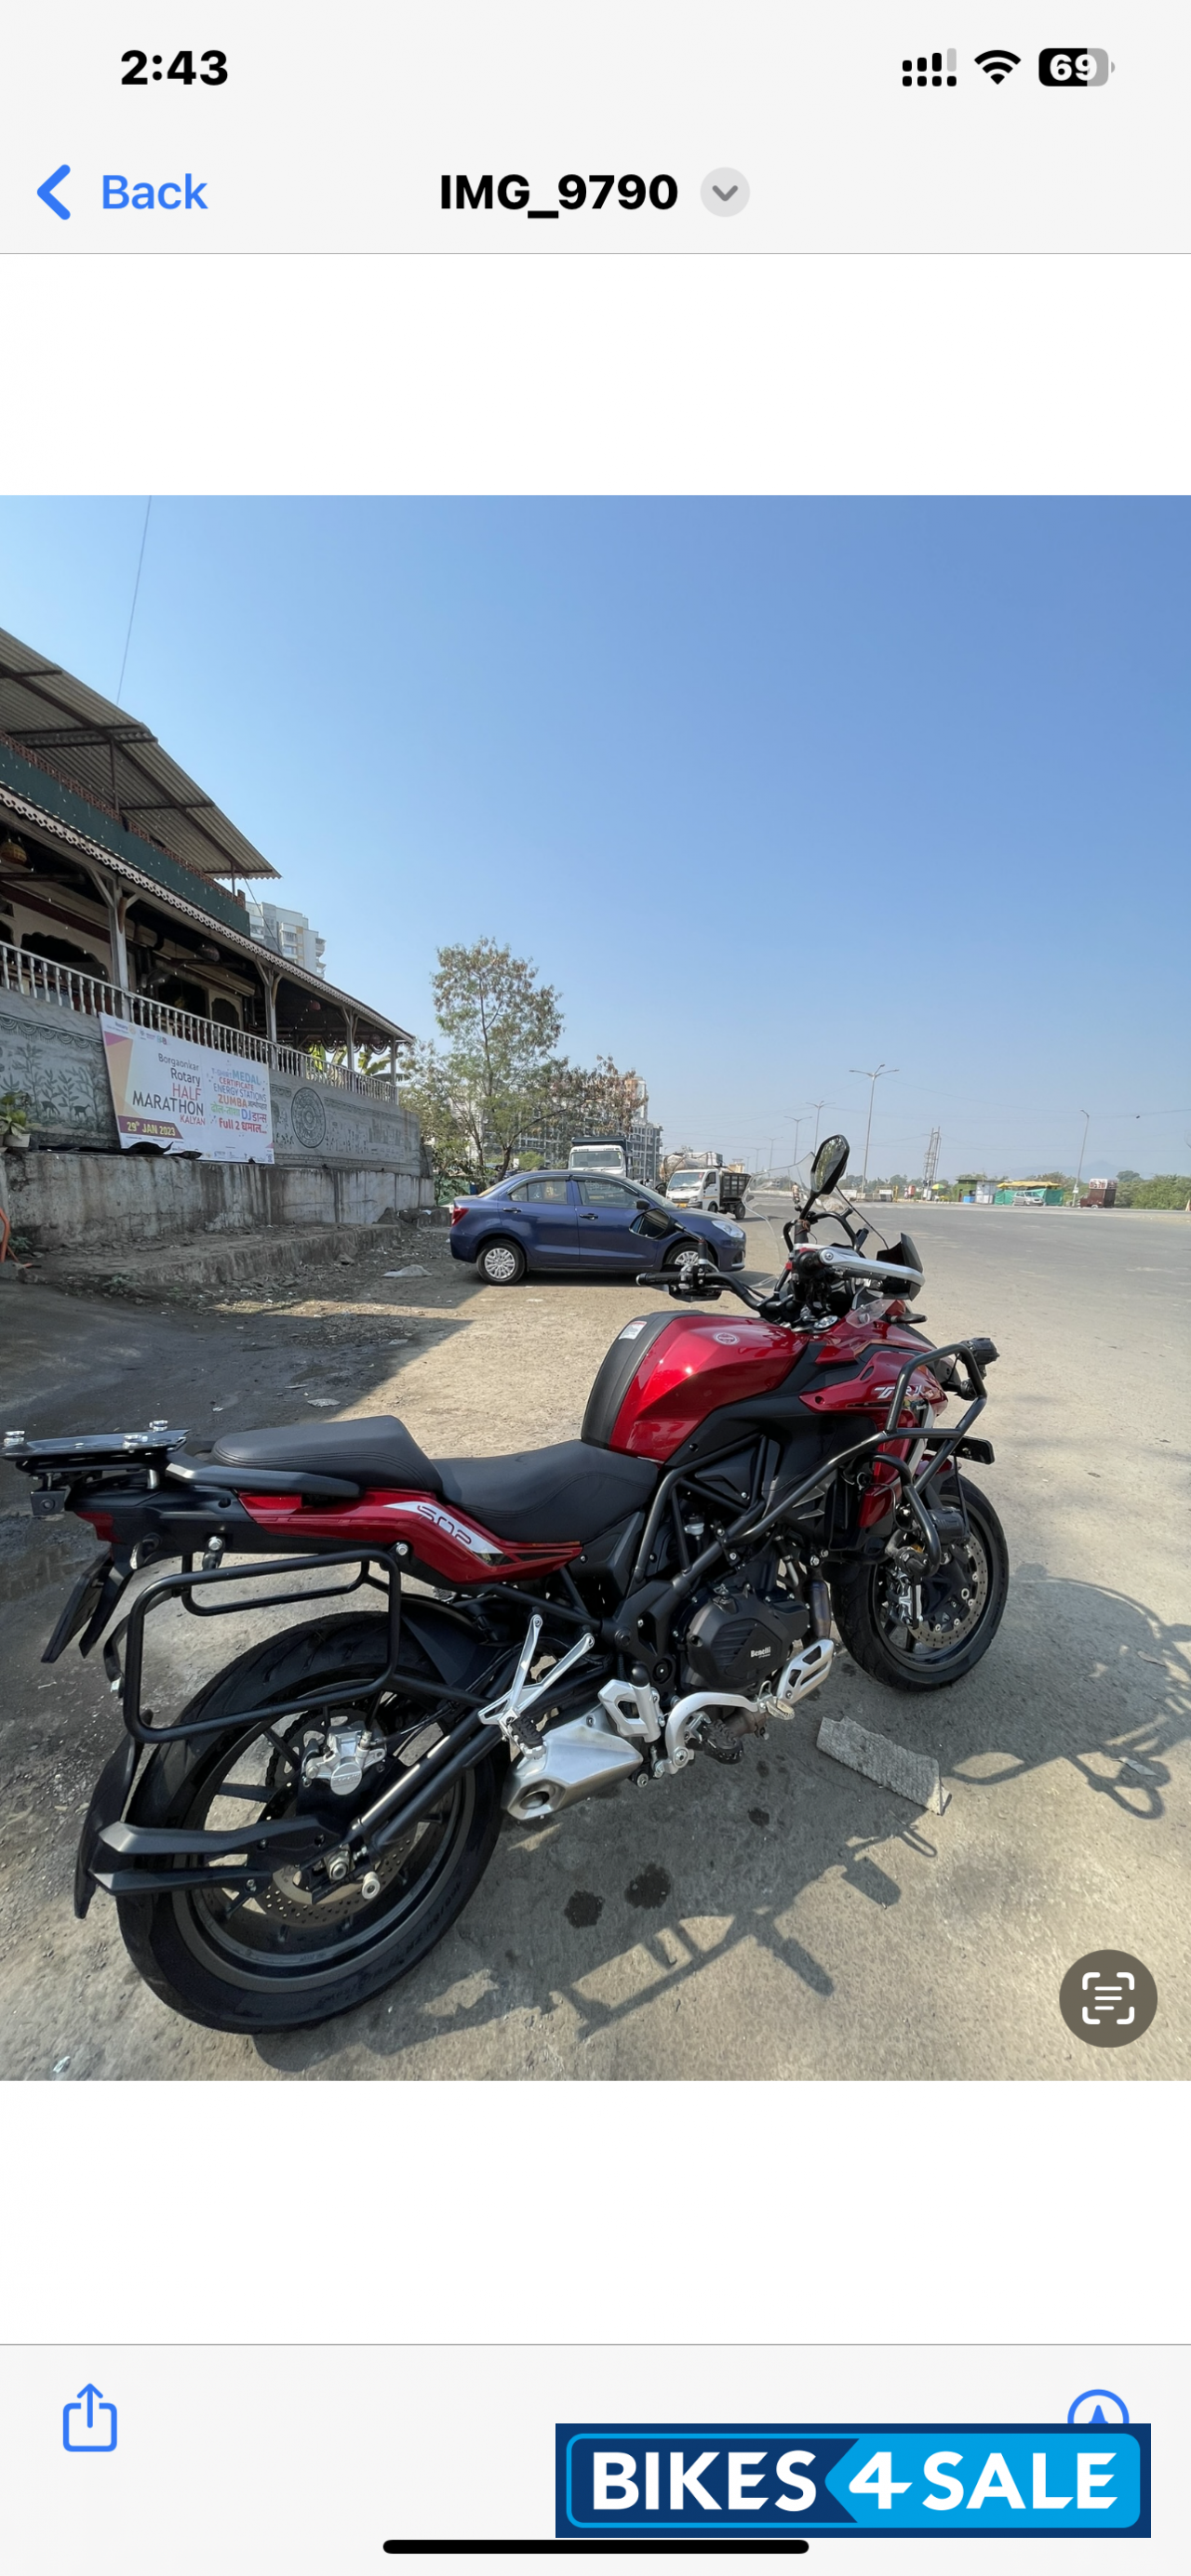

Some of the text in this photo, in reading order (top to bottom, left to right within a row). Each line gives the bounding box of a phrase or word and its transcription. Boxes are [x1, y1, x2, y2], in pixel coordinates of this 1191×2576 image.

[158, 1052, 199, 1071] Borgaonkar
[170, 1067, 200, 1087] Rotary
[219, 1076, 254, 1090] CERTIFICATE
[232, 1069, 261, 1086] MEDAL
[172, 1082, 202, 1101] HALF
[213, 1083, 267, 1102] ENERGY STATIONS
[132, 1090, 204, 1116] MARATHON
[218, 1093, 248, 1108] ZUMBA
[180, 1114, 206, 1126] KALYAN
[241, 1108, 251, 1120] DJ
[251, 1112, 267, 1123] डान्स
[142, 1123, 158, 1134] JAN
[159, 1126, 176, 1136] 2023
[234, 1120, 240, 1130] 2
